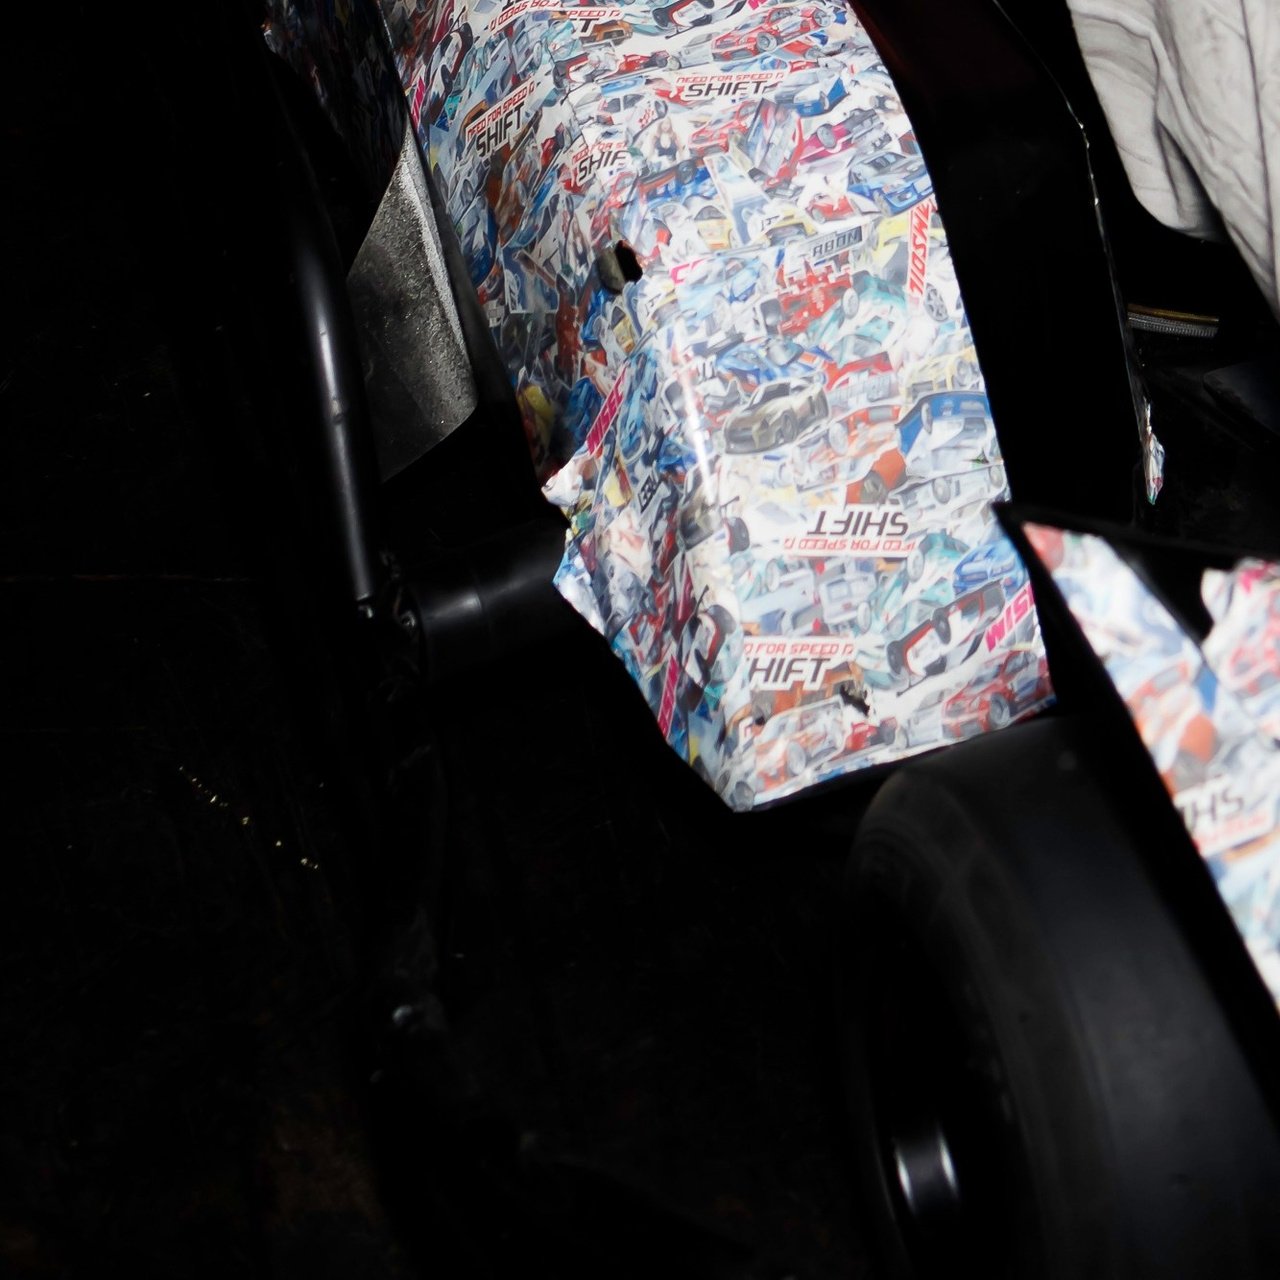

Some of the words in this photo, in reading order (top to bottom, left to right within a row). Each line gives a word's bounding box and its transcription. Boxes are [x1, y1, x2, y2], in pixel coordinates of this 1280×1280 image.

[567, 10, 606, 18] PEED
[735, 73, 774, 81] SPEED
[685, 80, 768, 98] SHIFT
[475, 101, 526, 158] SHIFT
[577, 149, 629, 183] SHIF
[807, 509, 909, 537] SHIFT
[798, 537, 848, 550] SPEED
[788, 642, 839, 655] SPEED
[750, 656, 832, 684] HIFT
